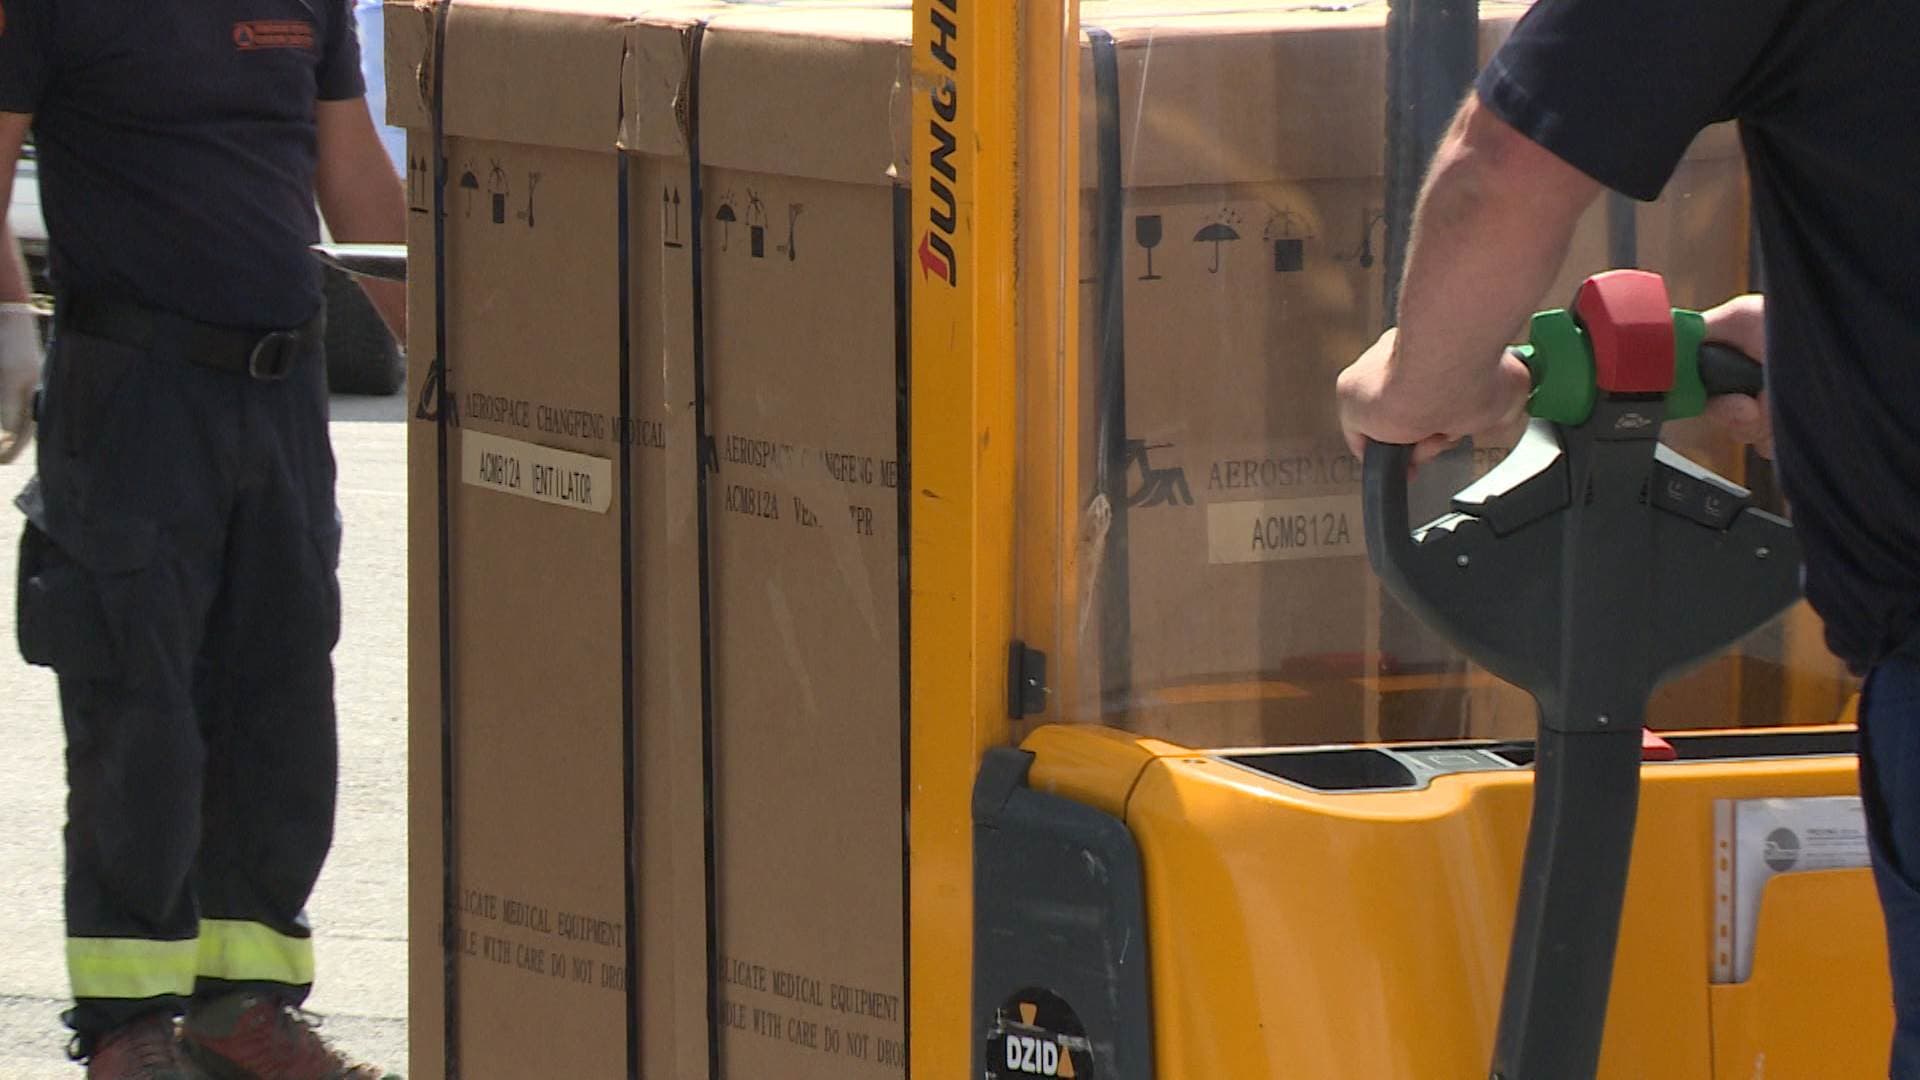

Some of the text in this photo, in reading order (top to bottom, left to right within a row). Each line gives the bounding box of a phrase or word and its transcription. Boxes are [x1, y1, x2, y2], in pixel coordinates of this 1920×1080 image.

[464, 392, 530, 428] AEROSPACE
[611, 415, 666, 448] MDICAL
[480, 449, 521, 489] ACM812A
[1252, 512, 1350, 551] ACM812A
[503, 898, 551, 933] MEDICAL
[558, 912, 622, 948] EQUIPMENT
[484, 935, 511, 964] WITH
[517, 943, 545, 974] CARE
[551, 952, 566, 979] DO
[573, 957, 594, 984] NOT
[773, 969, 823, 1006] MEDICAL
[831, 983, 899, 1022] EQUIPMENT
[753, 1008, 782, 1040] WITH
[788, 1017, 818, 1049] CARE
[824, 1026, 840, 1054] DO
[847, 1031, 869, 1060] NOT
